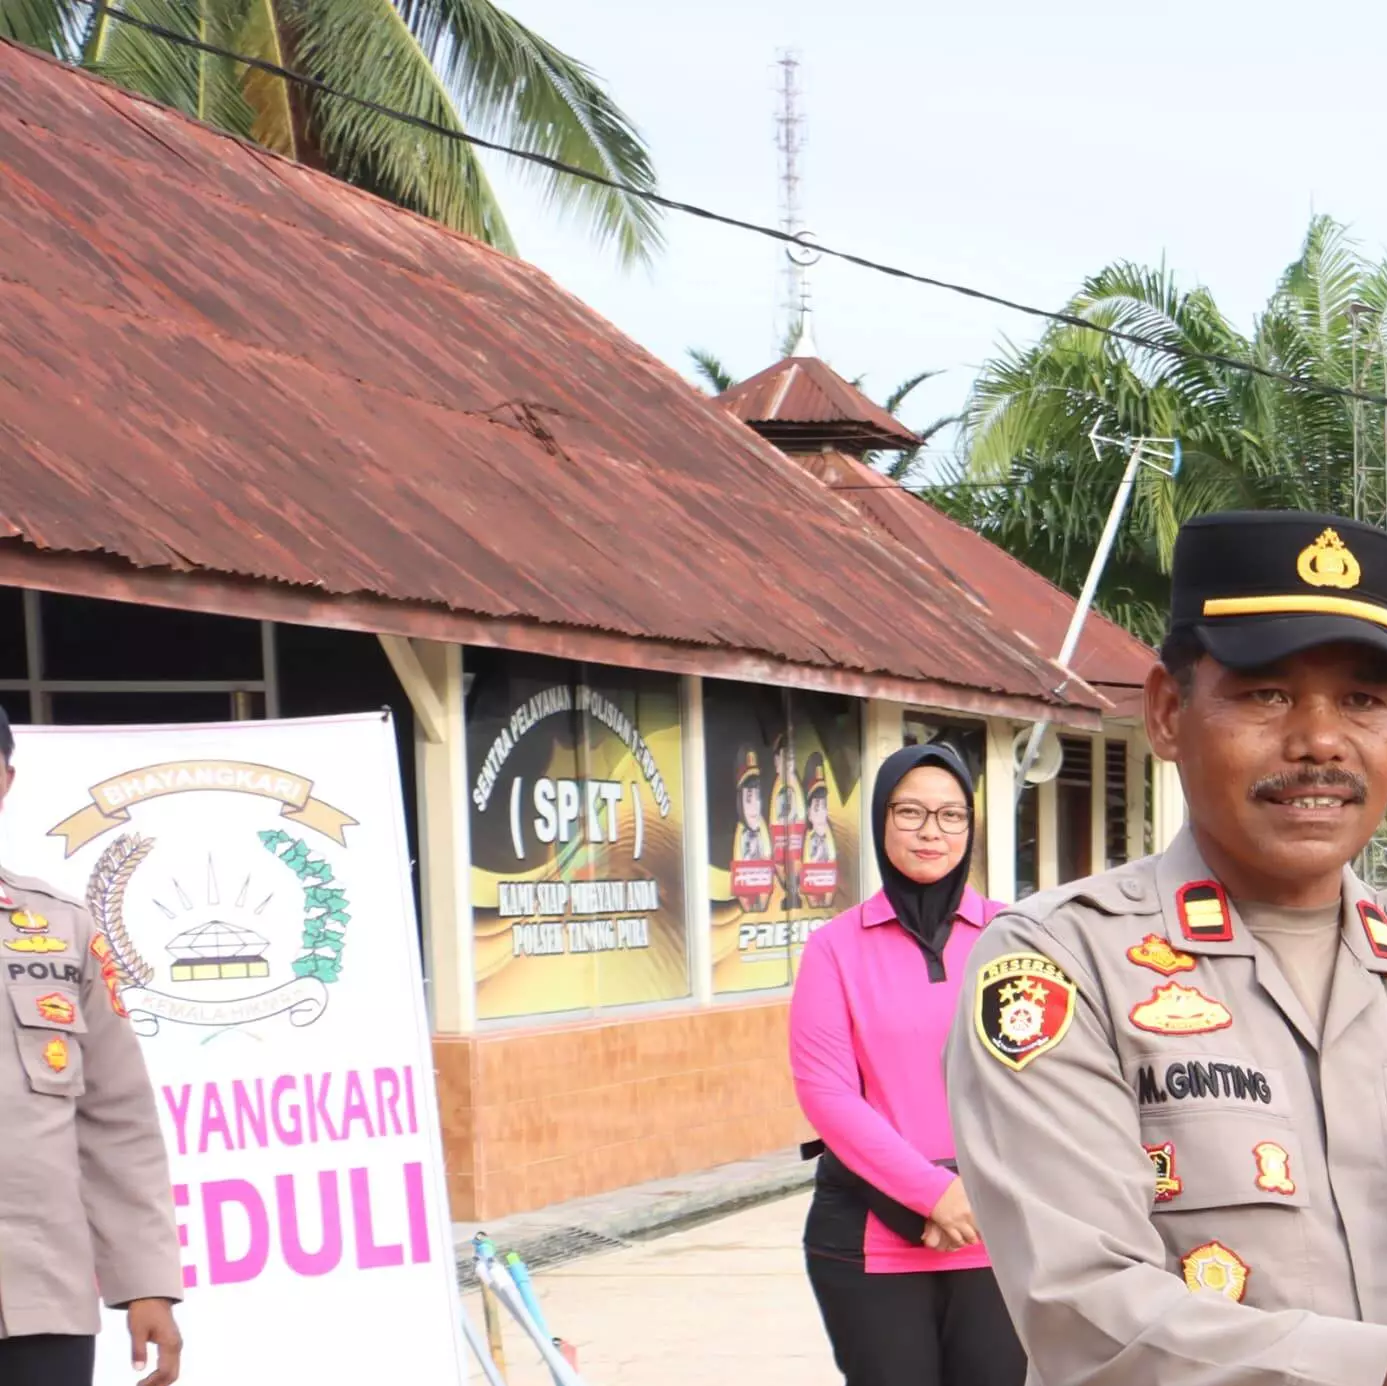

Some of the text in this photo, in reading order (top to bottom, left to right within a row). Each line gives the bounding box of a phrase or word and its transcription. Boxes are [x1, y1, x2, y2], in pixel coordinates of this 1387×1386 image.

[102, 766, 302, 806] BHAYANGKARI
[472, 727, 515, 812] SENTRA
[162, 1065, 419, 1156] YANGKARI
